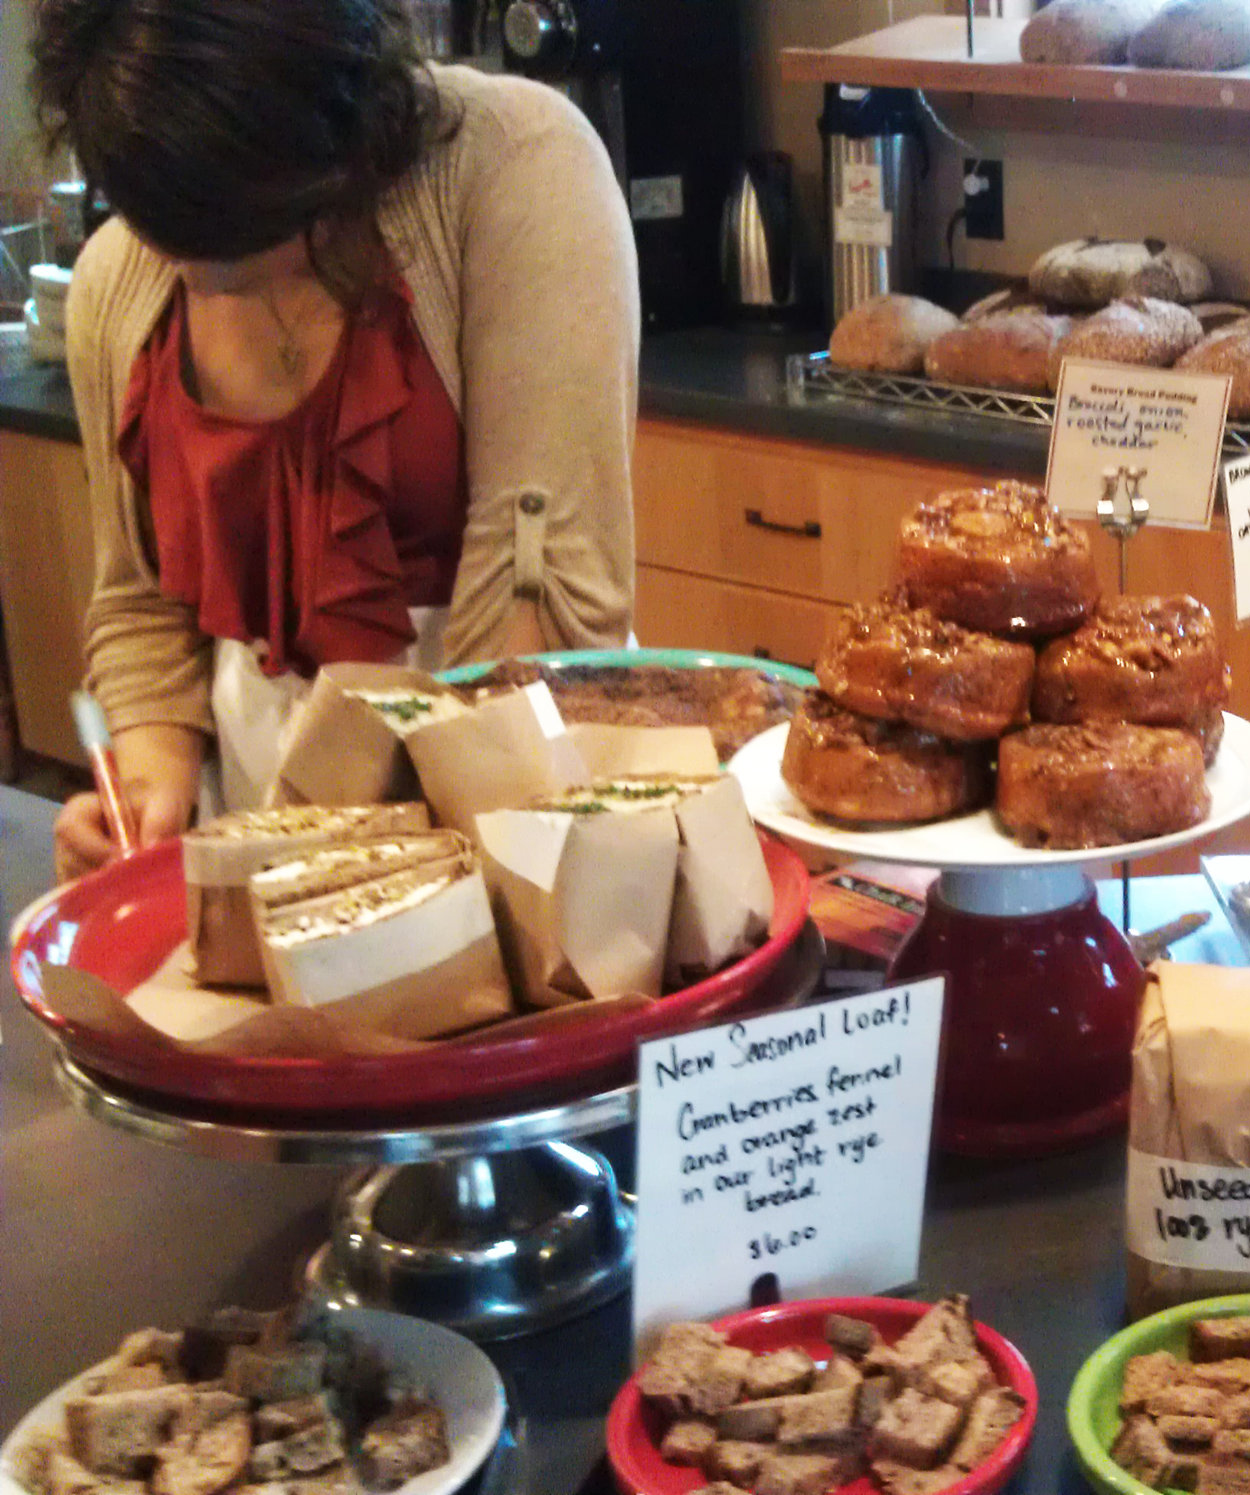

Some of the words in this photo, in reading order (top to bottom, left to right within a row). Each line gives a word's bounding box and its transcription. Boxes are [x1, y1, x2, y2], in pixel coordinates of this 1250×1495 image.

[1158, 391, 1198, 405] Pudding
[655, 1043, 717, 1088] New
[727, 1012, 827, 1068] Seasonal
[841, 990, 912, 1037] Loaf!
[826, 1053, 903, 1096] fennel
[682, 1143, 730, 1175] and
[740, 1118, 818, 1153] orange
[826, 1095, 878, 1126] zest
[681, 1186, 705, 1205] in
[713, 1170, 750, 1193] our
[767, 1147, 827, 1186] light
[836, 1132, 881, 1164] rye
[747, 1225, 819, 1260] $6.00
